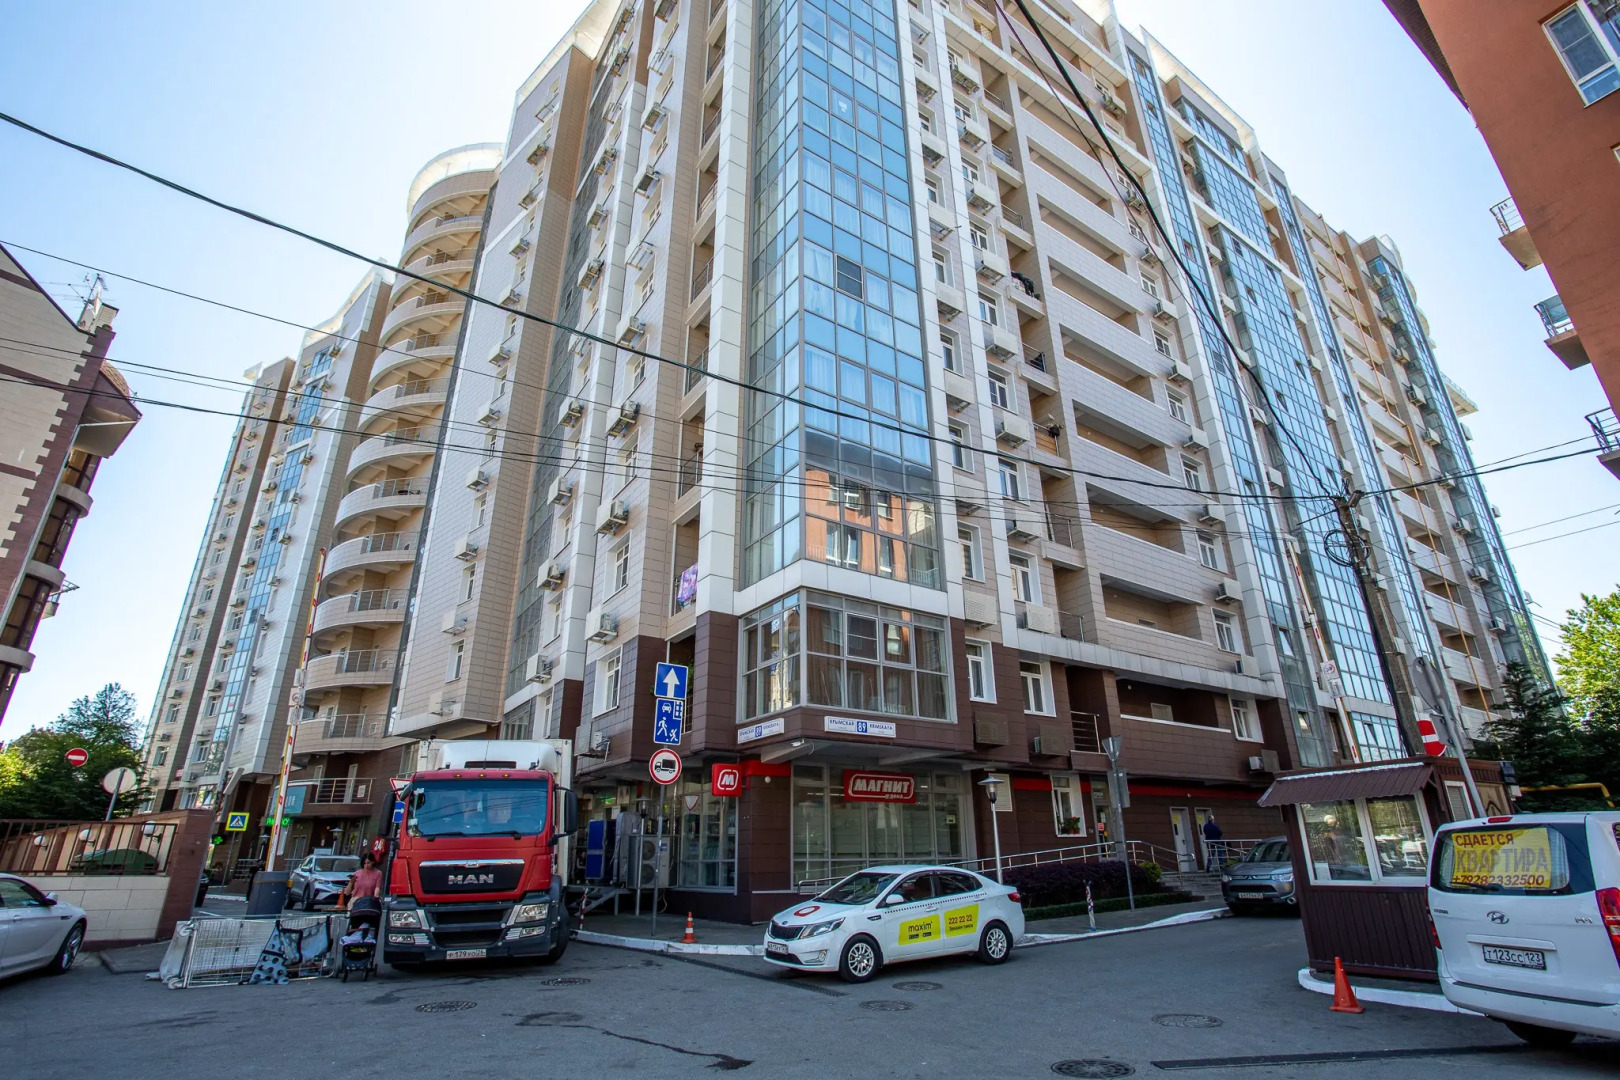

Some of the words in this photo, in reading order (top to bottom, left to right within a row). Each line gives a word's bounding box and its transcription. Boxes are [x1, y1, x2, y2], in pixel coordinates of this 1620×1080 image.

[858, 722, 867, 732] 89
[854, 778, 909, 793] МАГНИТ
[1455, 833, 1514, 847] СДАЕТСЯ
[1456, 847, 1548, 873] КВАРТИРА
[448, 873, 494, 884] MAN
[908, 921, 932, 932] maxim
